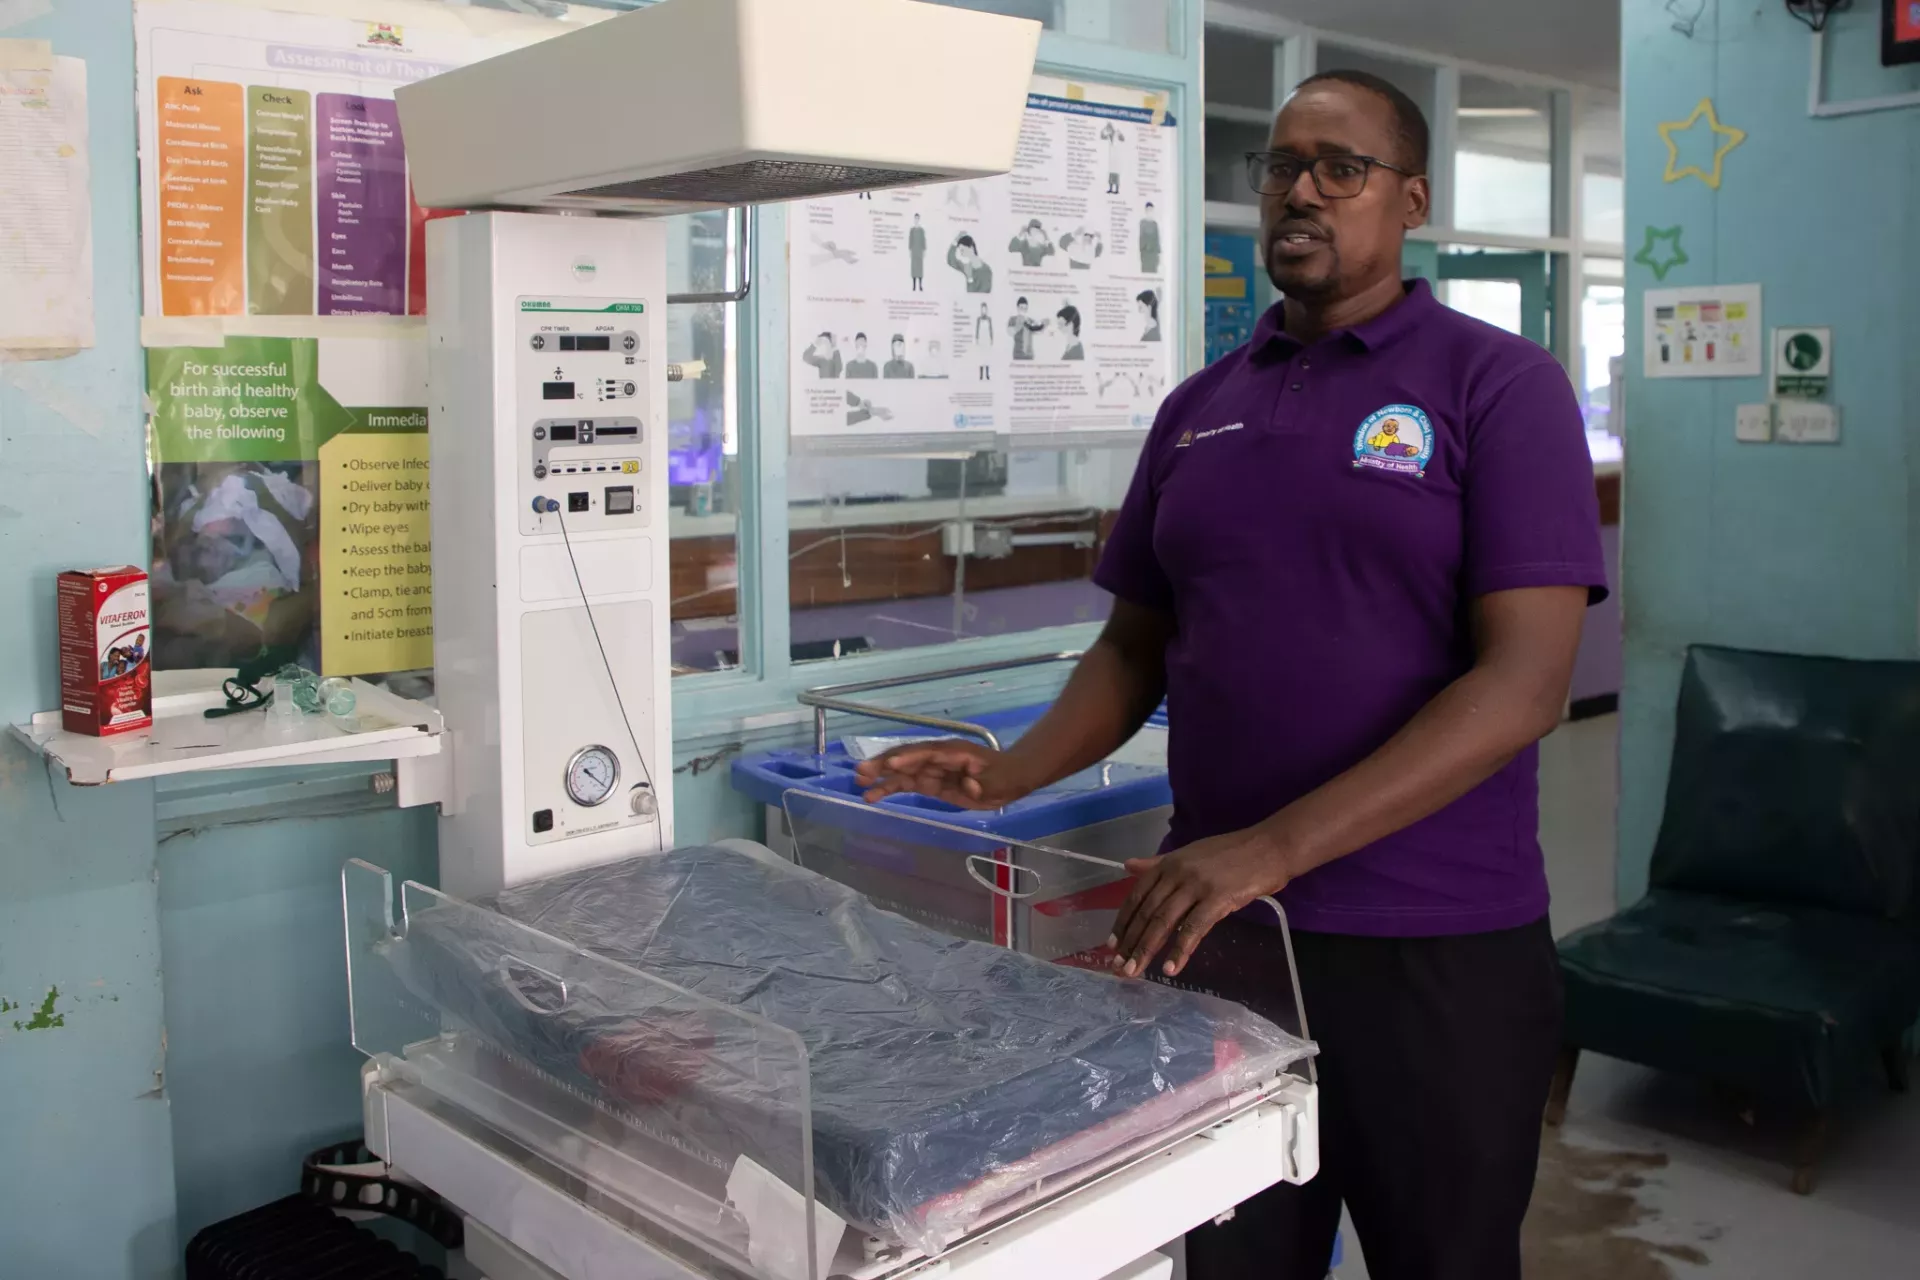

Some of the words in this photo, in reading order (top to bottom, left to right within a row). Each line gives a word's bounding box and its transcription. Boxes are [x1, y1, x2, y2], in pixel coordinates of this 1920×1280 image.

[274, 50, 371, 73] Assessment
[376, 59, 391, 74] of
[395, 61, 425, 77] The
[184, 85, 203, 95] Ask
[262, 93, 292, 104] Check
[346, 101, 366, 111] Look
[330, 117, 352, 125] Screen
[166, 138, 200, 147] Condition
[347, 135, 385, 145] Examination
[331, 232, 347, 240] Eyes
[331, 278, 368, 287] Respiratory
[183, 361, 208, 377] For
[212, 361, 287, 377] successful
[170, 382, 208, 397] birth
[212, 383, 241, 397] and
[245, 383, 300, 401] healthy
[184, 403, 226, 421] baby,
[229, 403, 288, 419] observe
[1377, 406, 1413, 417] Newborn
[1419, 415, 1431, 433] Child
[187, 425, 213, 439] the
[216, 425, 285, 442] following
[349, 459, 400, 471] Observe
[1360, 457, 1385, 468] Ministry
[1396, 463, 1418, 471] Health
[350, 480, 391, 492] Deliver
[395, 480, 423, 492] baby
[349, 502, 371, 515] Dry
[373, 501, 403, 514] baby
[349, 524, 380, 536] Wipe
[383, 523, 409, 535] eyes
[350, 545, 389, 556] Assess
[391, 543, 411, 554] the
[350, 566, 381, 578] Keep
[384, 564, 404, 575] the
[350, 587, 393, 599] Clamp,
[395, 585, 411, 596] tie
[100, 610, 146, 625] VITAFERON
[351, 608, 374, 620] and
[377, 607, 403, 619] 5cm
[406, 605, 432, 616] from
[351, 629, 394, 641] Initiate
